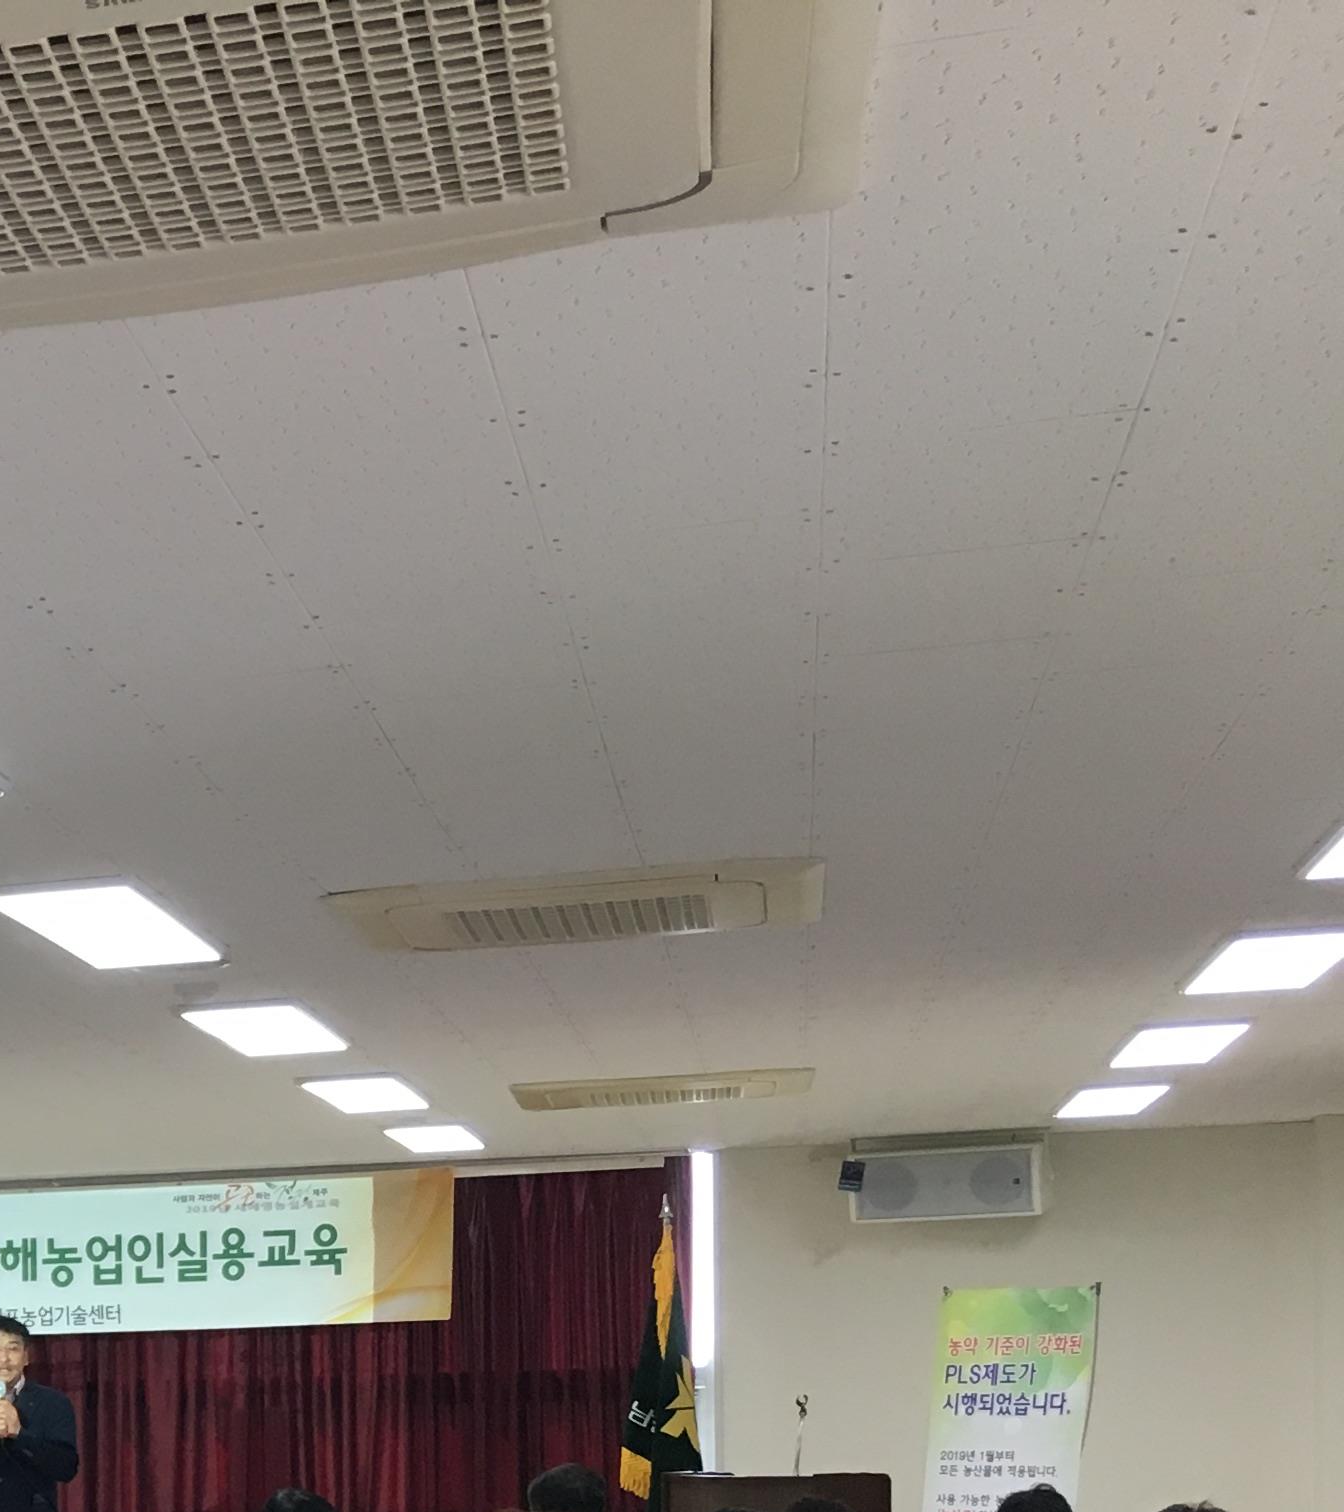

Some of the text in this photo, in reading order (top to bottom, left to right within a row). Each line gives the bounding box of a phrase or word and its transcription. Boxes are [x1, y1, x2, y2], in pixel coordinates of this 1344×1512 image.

[949, 1334, 1082, 1357] 농약 기준이 강화된
[945, 1362, 1036, 1386] PLS제도가
[942, 1392, 1071, 1416] 시행되었습니다.
[940, 1450, 1015, 1462] 2019년 1월부터
[939, 1465, 958, 1476] 모든
[936, 1494, 956, 1506] 사용
[961, 1494, 990, 1507] 가능한
